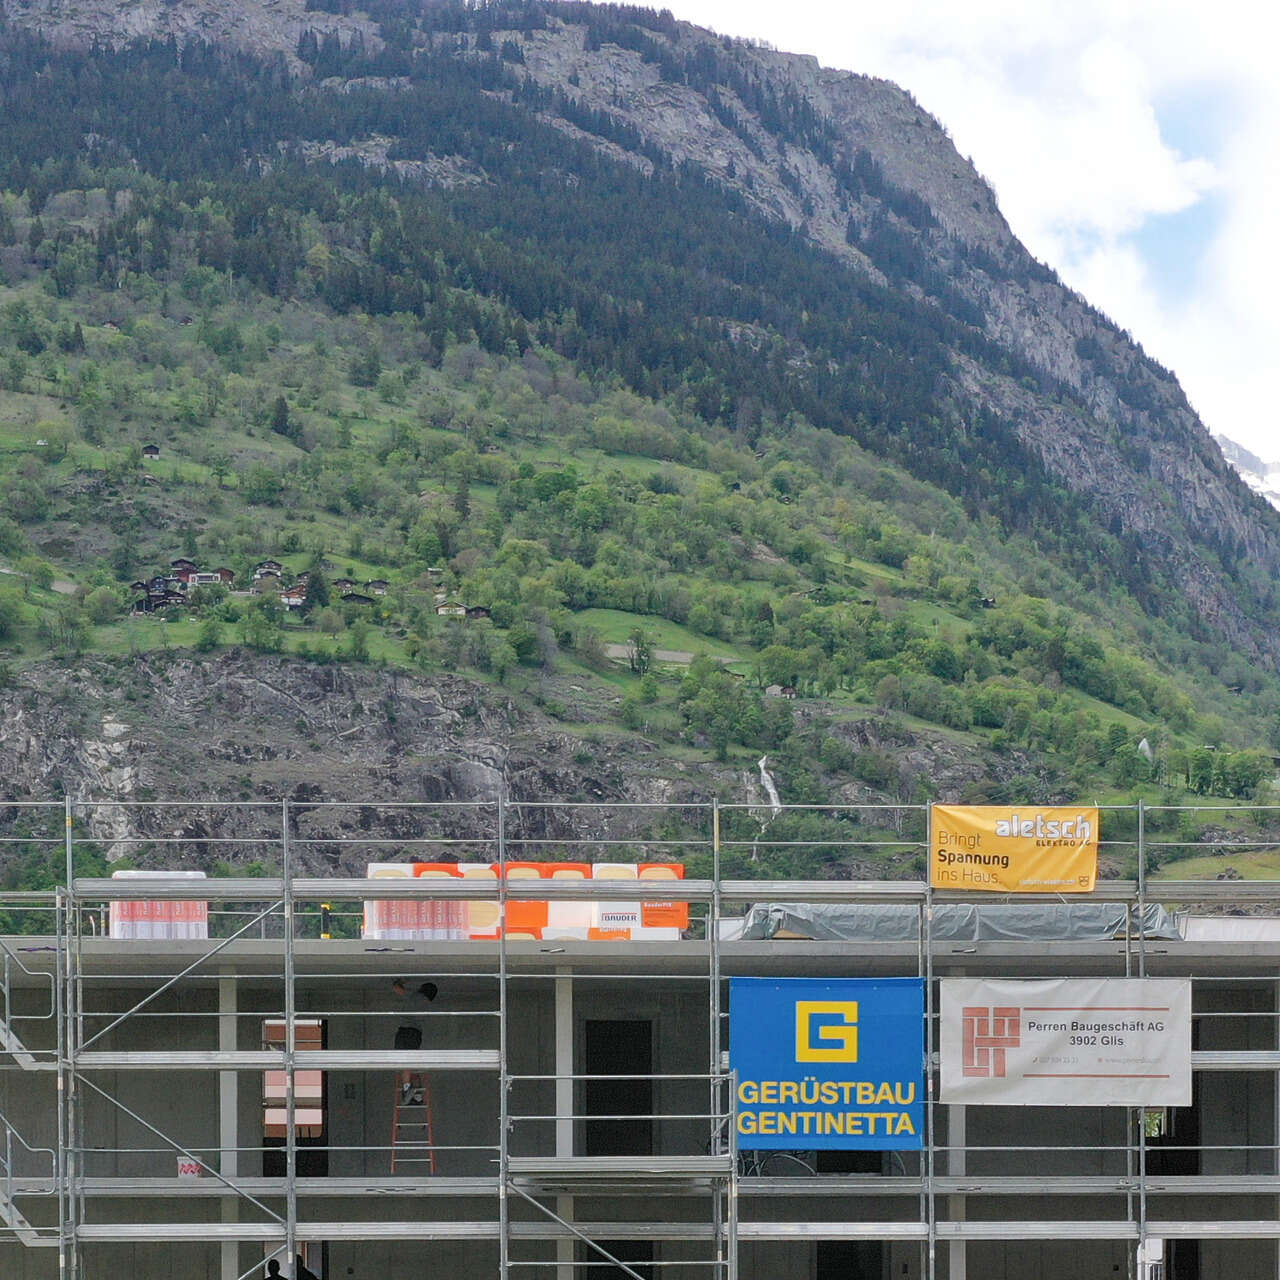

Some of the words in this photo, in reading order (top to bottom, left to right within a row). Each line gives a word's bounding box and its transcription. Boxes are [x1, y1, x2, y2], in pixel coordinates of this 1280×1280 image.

[995, 815, 1090, 839] aletsch
[938, 831, 982, 849] Bringt
[938, 849, 1010, 868] Spannung
[937, 867, 958, 881] ins
[962, 869, 1002, 883] Haus.
[795, 1001, 858, 1063] G
[1028, 1021, 1067, 1032] Perren
[1147, 1022, 1164, 1032] AG
[1069, 1036, 1097, 1046] 3902
[1100, 1036, 1124, 1046] Glis
[737, 1076, 916, 1105] GERÜSTBAU
[736, 1111, 915, 1135] GENTINETTA
